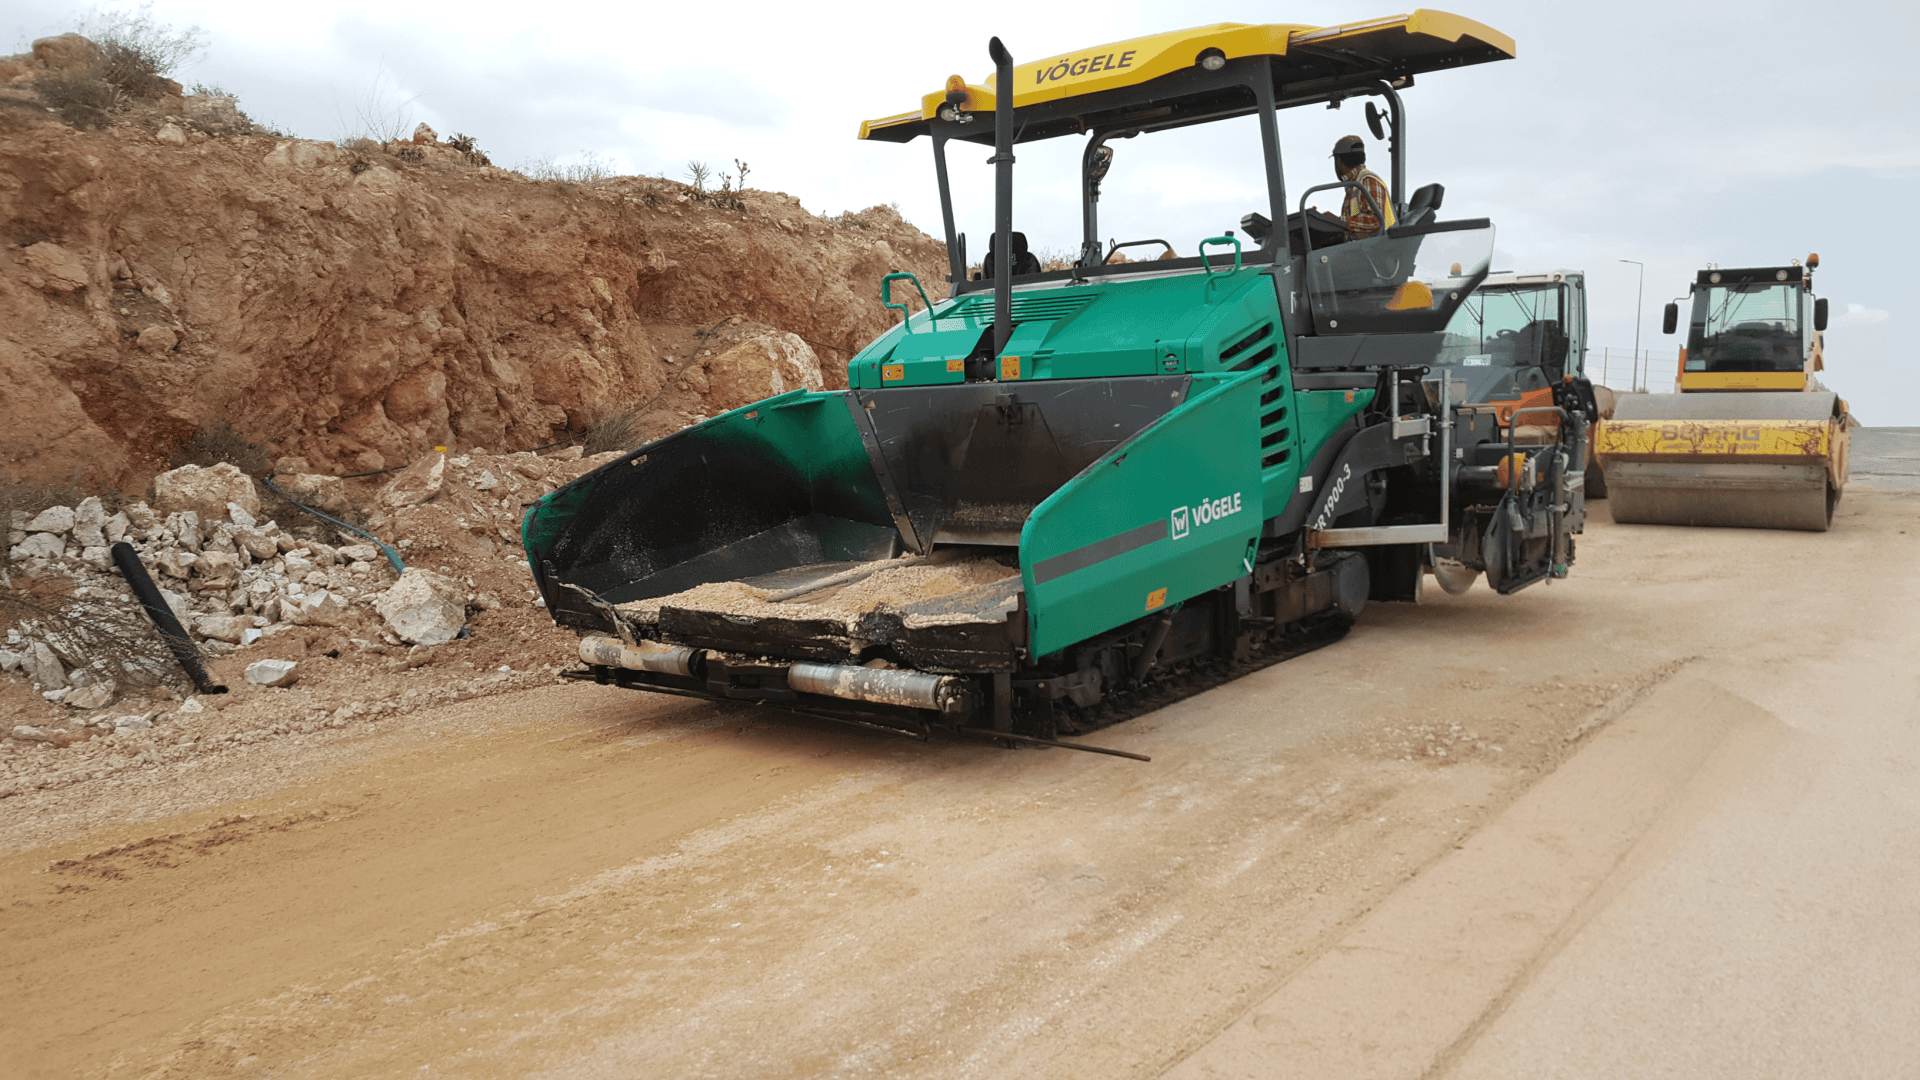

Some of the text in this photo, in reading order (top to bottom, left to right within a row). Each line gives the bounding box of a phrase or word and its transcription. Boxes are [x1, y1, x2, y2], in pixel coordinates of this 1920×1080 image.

[1036, 50, 1137, 85] VÖGELE
[1324, 463, 1351, 518] 1900-3
[1192, 492, 1242, 527] VÖGELE
